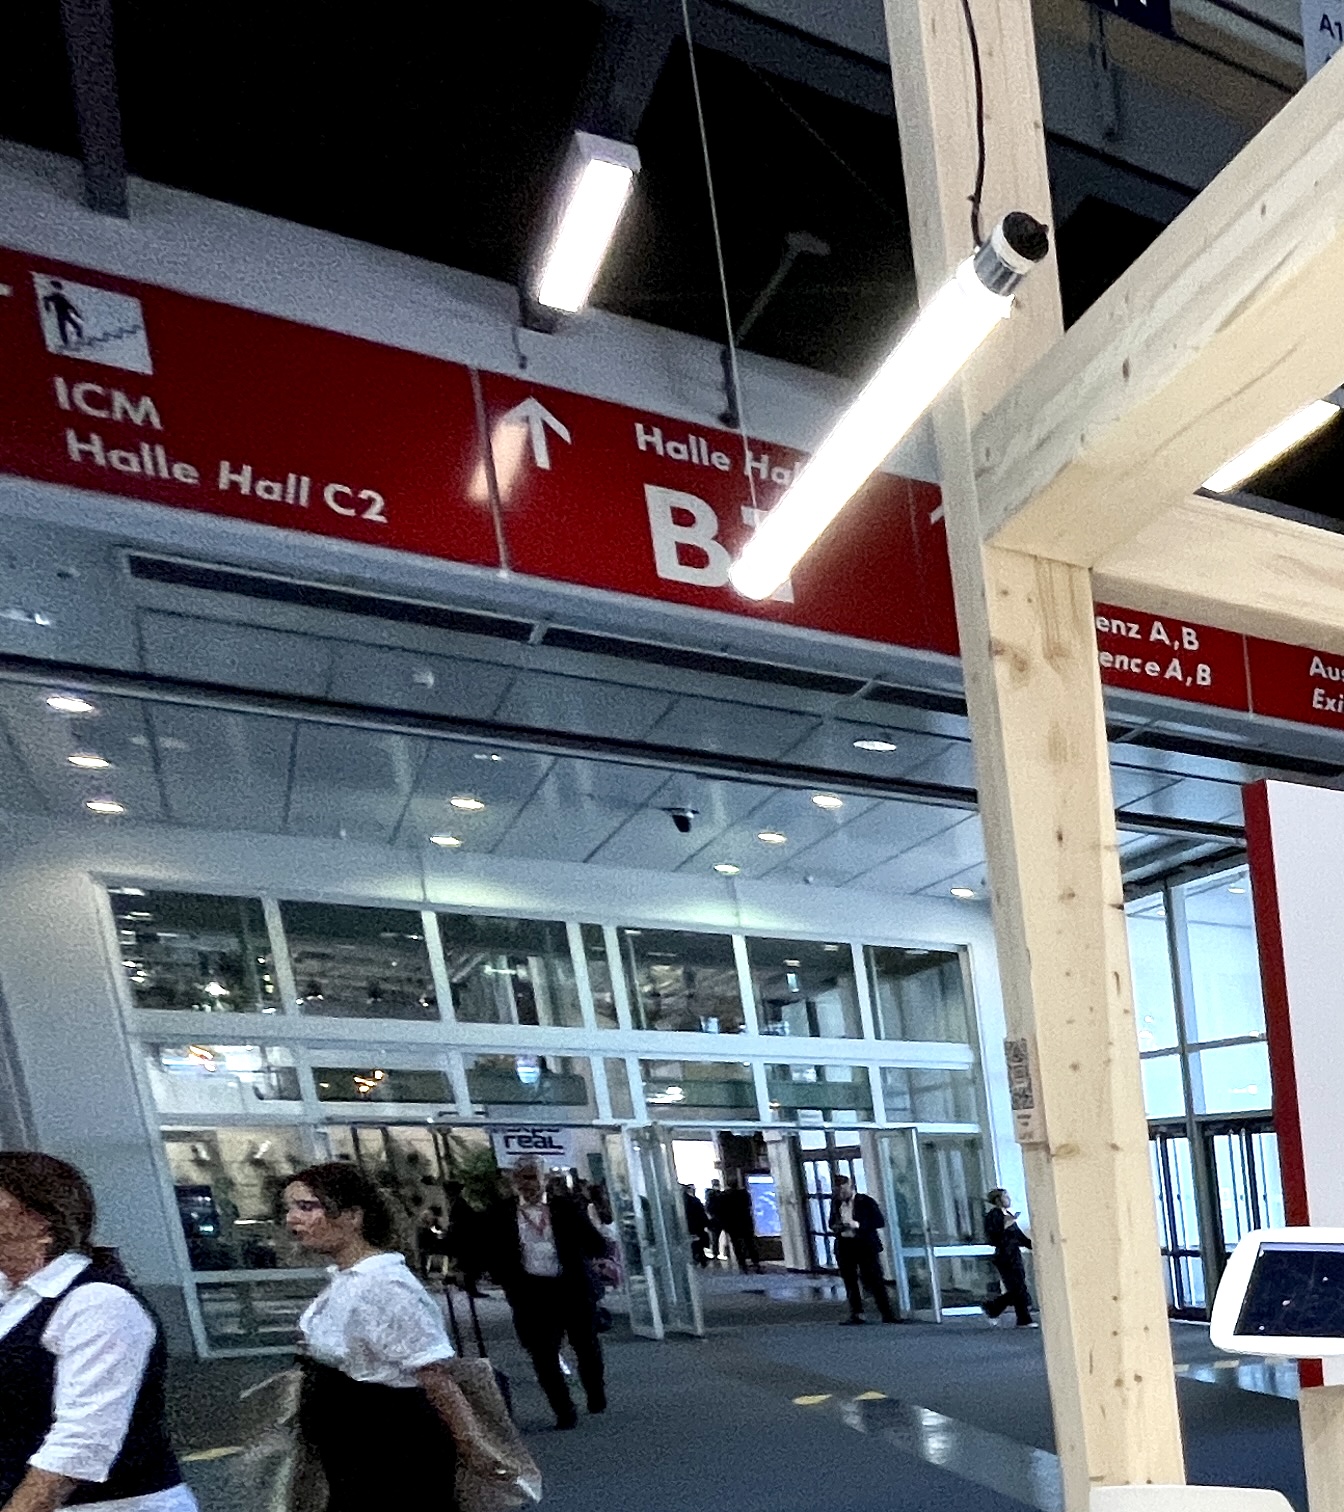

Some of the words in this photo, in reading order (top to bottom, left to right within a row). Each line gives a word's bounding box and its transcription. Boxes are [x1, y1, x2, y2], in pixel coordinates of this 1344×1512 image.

[54, 377, 163, 430] ICM
[634, 422, 731, 472] Halle
[66, 428, 200, 485] Halle
[218, 460, 311, 508] Hall
[323, 482, 388, 523] C2
[643, 483, 794, 603] B
[1095, 616, 1142, 639] enz
[1099, 651, 1161, 676] ence
